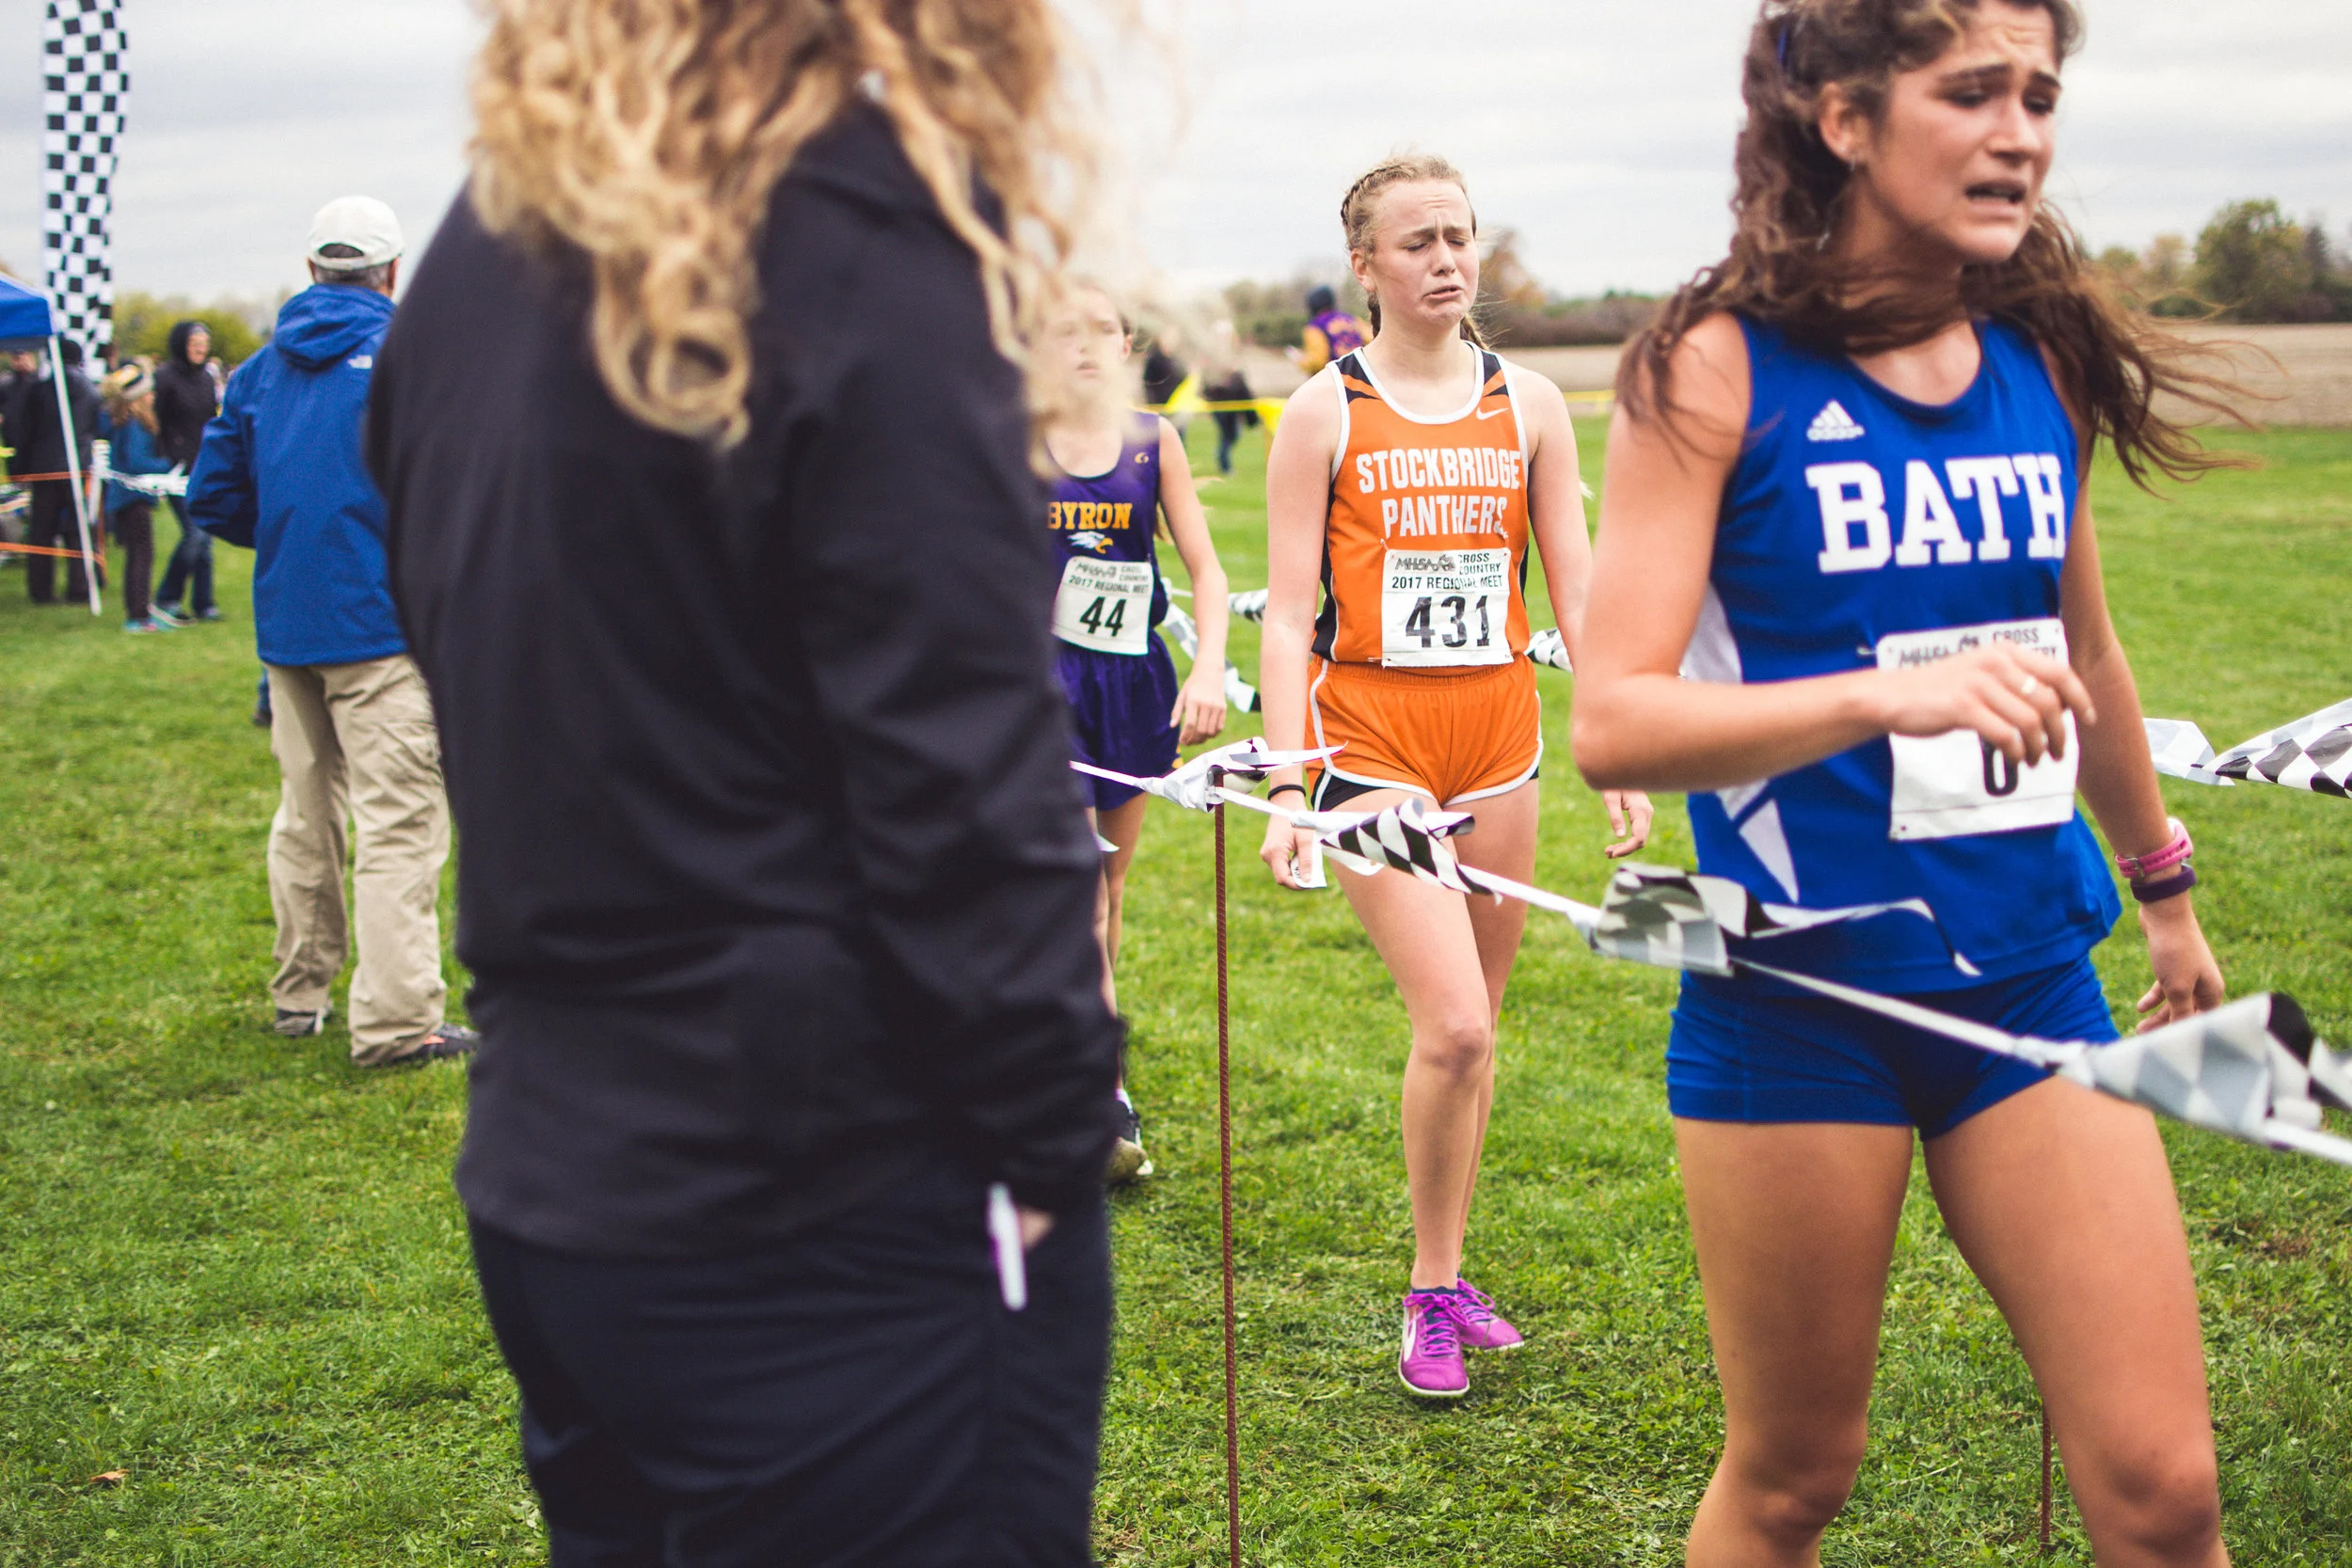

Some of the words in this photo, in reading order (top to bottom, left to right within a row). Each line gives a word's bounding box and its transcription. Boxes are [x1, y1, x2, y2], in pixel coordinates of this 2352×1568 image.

[1356, 447, 1520, 494] STOCKBRIDGE
[1046, 501, 1133, 530] BYRON
[1381, 495, 1508, 539] PANTHERS
[1805, 453, 2066, 574] BATH
[1069, 575, 1092, 587] 2017
[1391, 576, 1422, 589] 2017
[1480, 575, 1502, 588] MEET
[1079, 596, 1127, 637] 44
[1405, 594, 1490, 648] 431
[1993, 627, 2040, 644] CROSS
